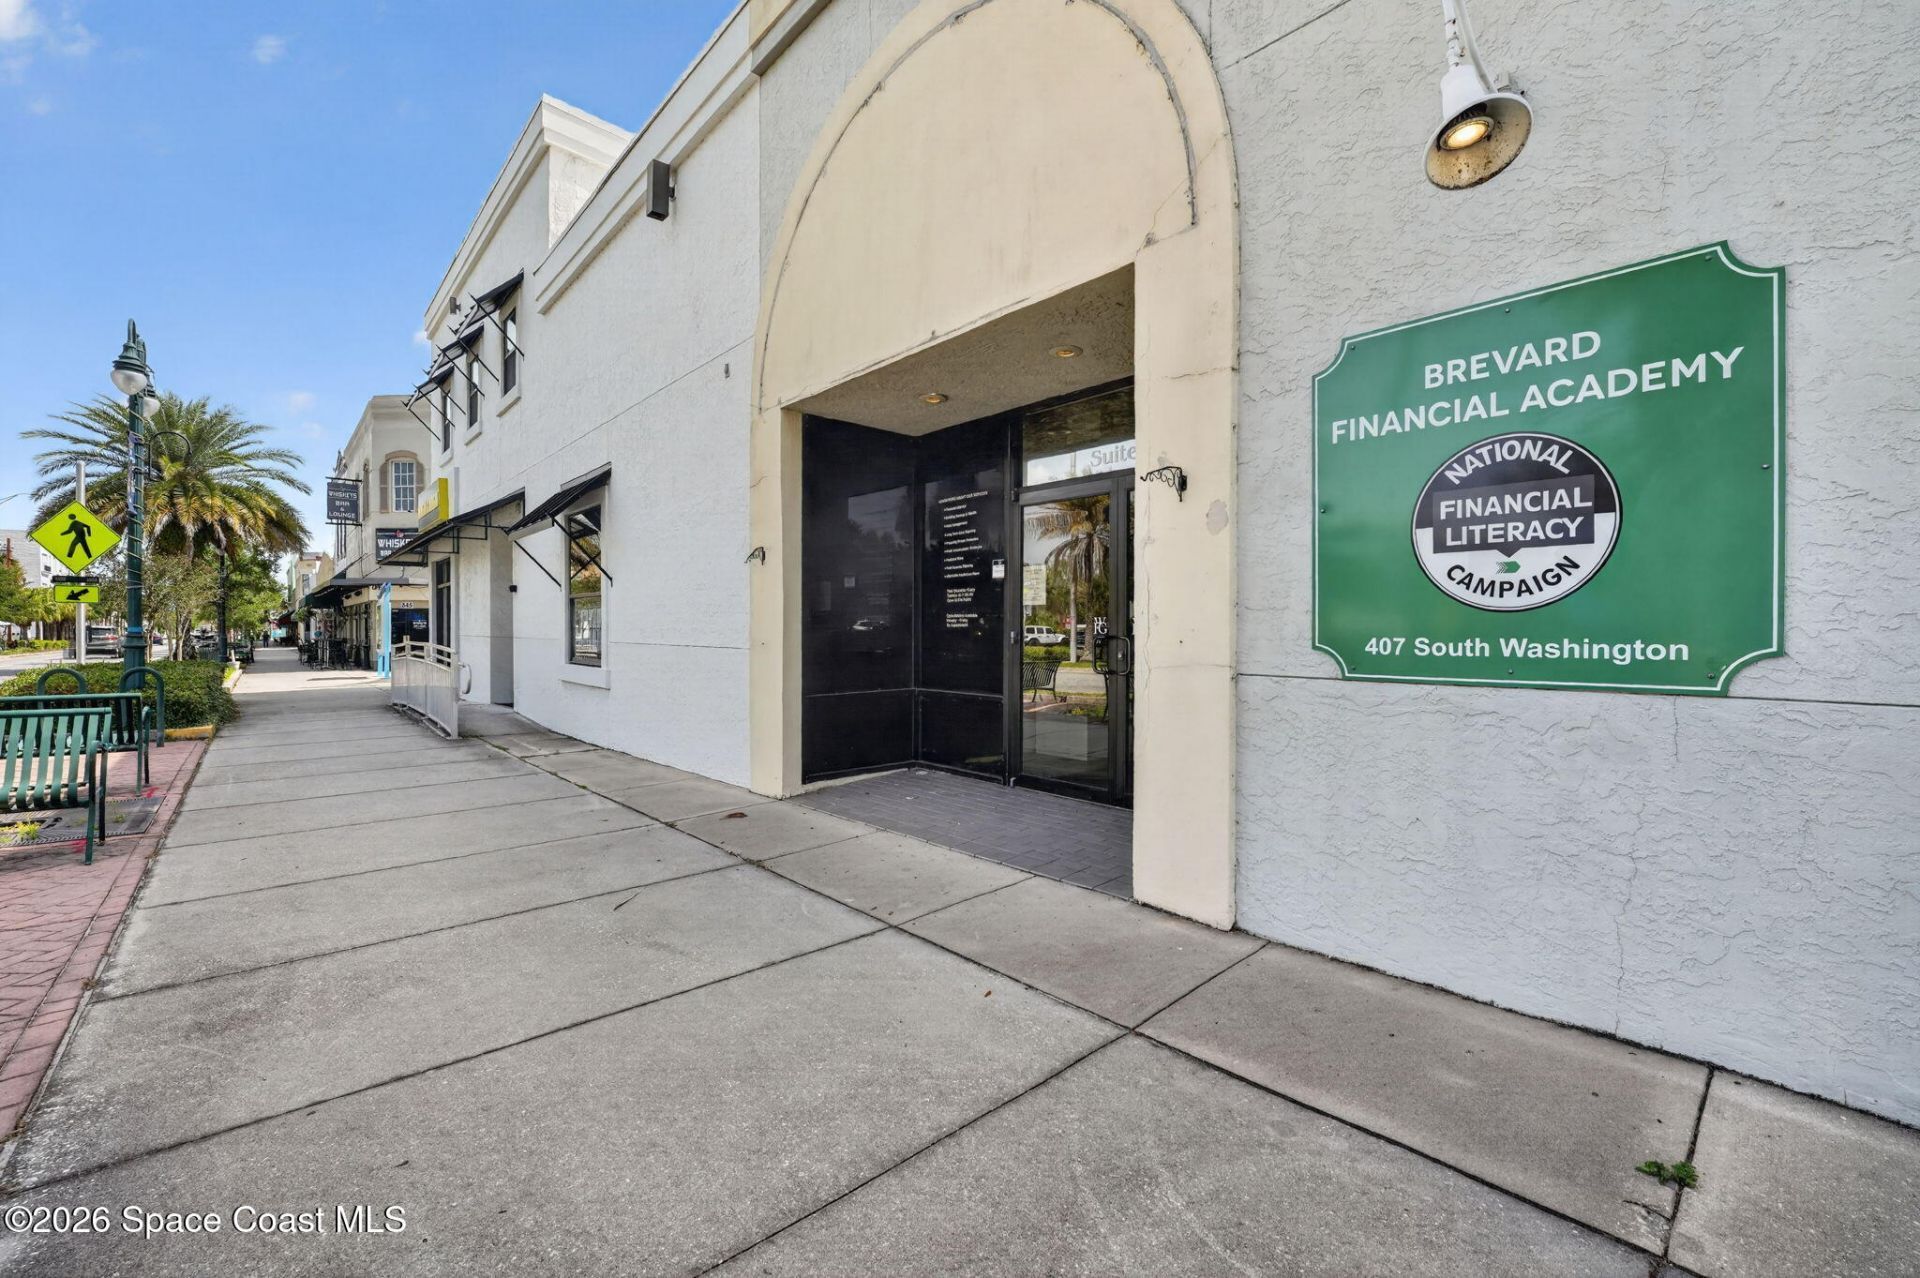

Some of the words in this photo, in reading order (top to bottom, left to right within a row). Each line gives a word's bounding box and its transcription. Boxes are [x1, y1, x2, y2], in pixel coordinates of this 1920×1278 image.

[1424, 330, 1602, 389] BREVARD
[1331, 392, 1510, 444] FINANCIAL
[1520, 346, 1745, 413] ACADEMY
[1444, 439, 1574, 485] NATIONAL
[328, 511, 356, 519] LOUNGE
[1439, 487, 1593, 521] FINANCIAL
[1445, 516, 1585, 547] LITERACY
[1446, 555, 1581, 598] CAMPAIGN
[1365, 638, 1406, 656] 407
[1414, 637, 1490, 658] South
[1500, 638, 1690, 666] Washington
